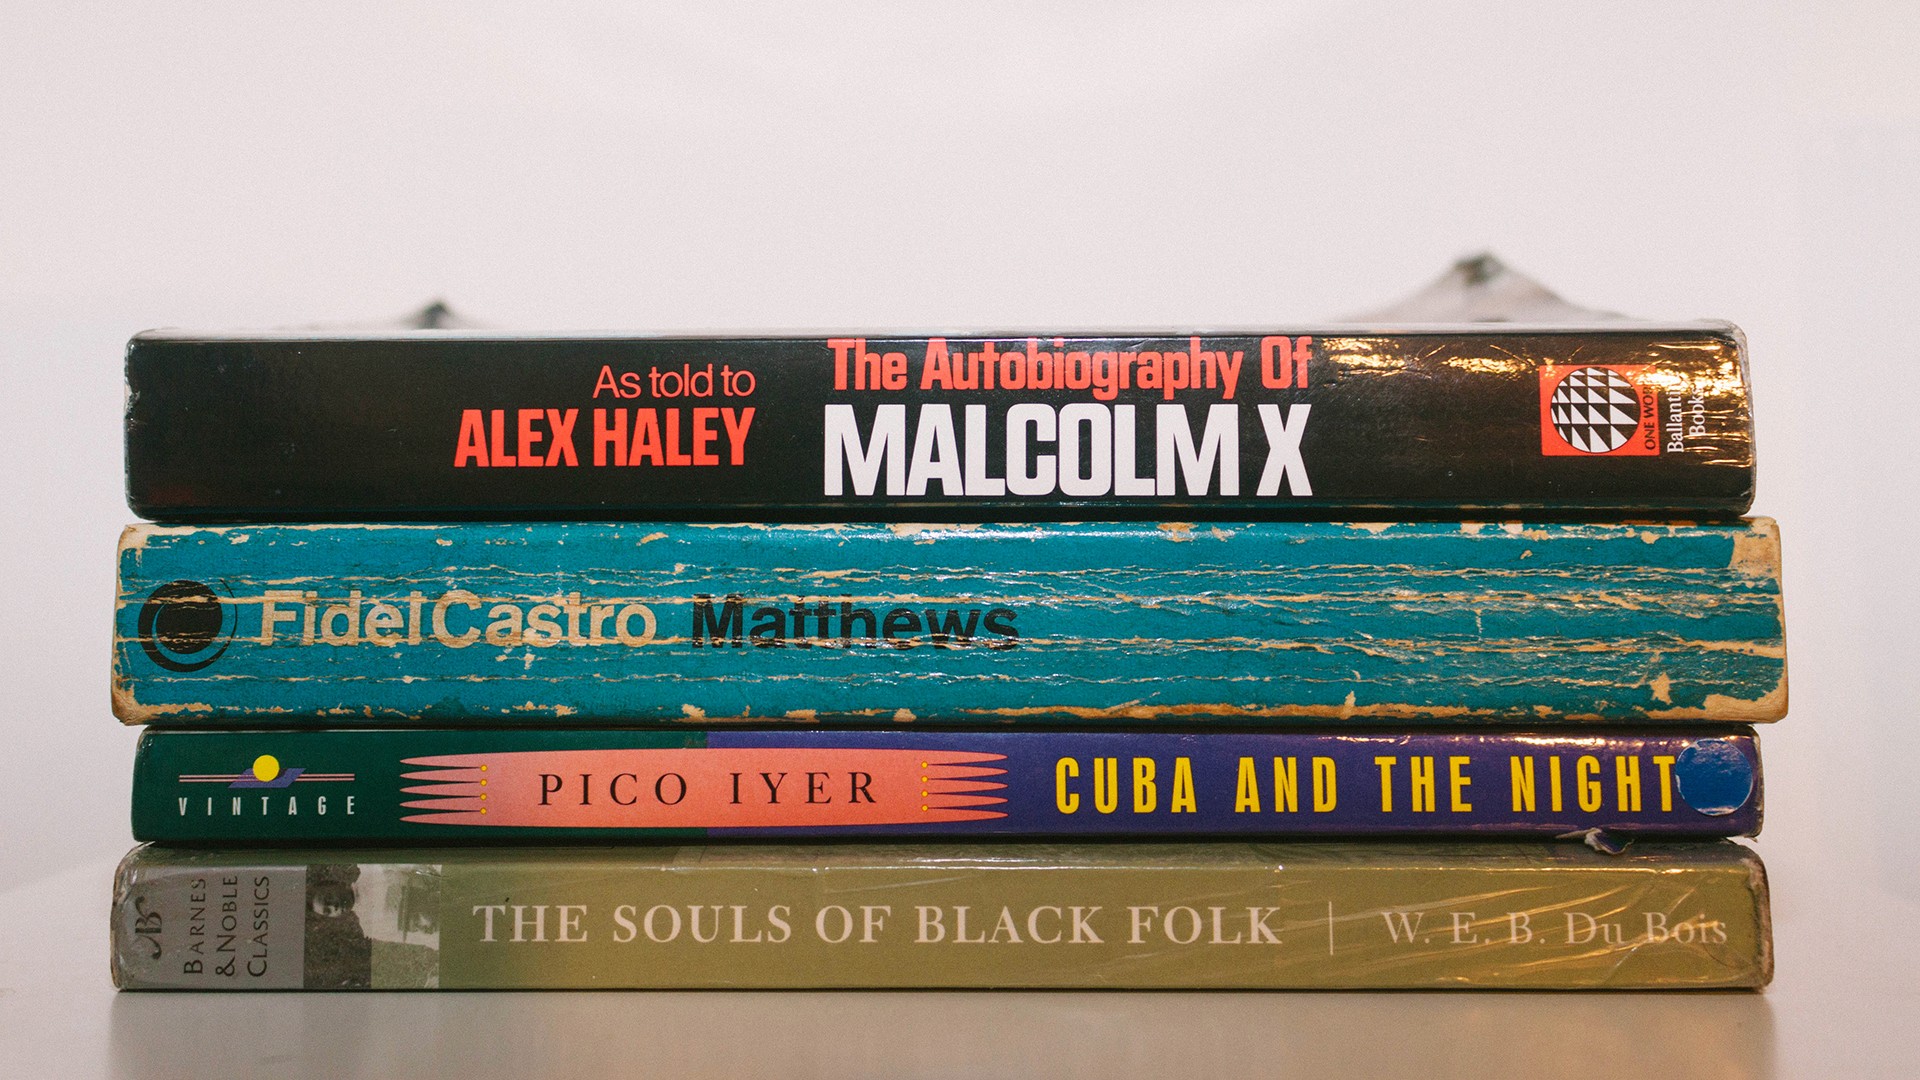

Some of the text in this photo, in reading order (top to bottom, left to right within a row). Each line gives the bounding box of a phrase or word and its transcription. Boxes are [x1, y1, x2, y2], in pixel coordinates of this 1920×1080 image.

[592, 363, 756, 399] As told to
[827, 336, 1313, 401] The Autobiography Of
[453, 407, 756, 468] ALEX HALEY
[824, 403, 1313, 497] MALCOLM X
[1643, 422, 1657, 451] ONE
[260, 589, 656, 648] Fidel Castro
[692, 593, 1019, 650] Matthews
[178, 796, 355, 816] VINTAGE
[538, 772, 877, 807] PICO IYER
[1055, 755, 1676, 814] CUBA AND THE NIGHT
[184, 878, 206, 975] BARNES
[247, 875, 270, 978] CLASSICS
[473, 905, 1283, 945] THE SOULS OF BLACK FOLK
[1381, 911, 1728, 945] W. E. B. Du Bois
